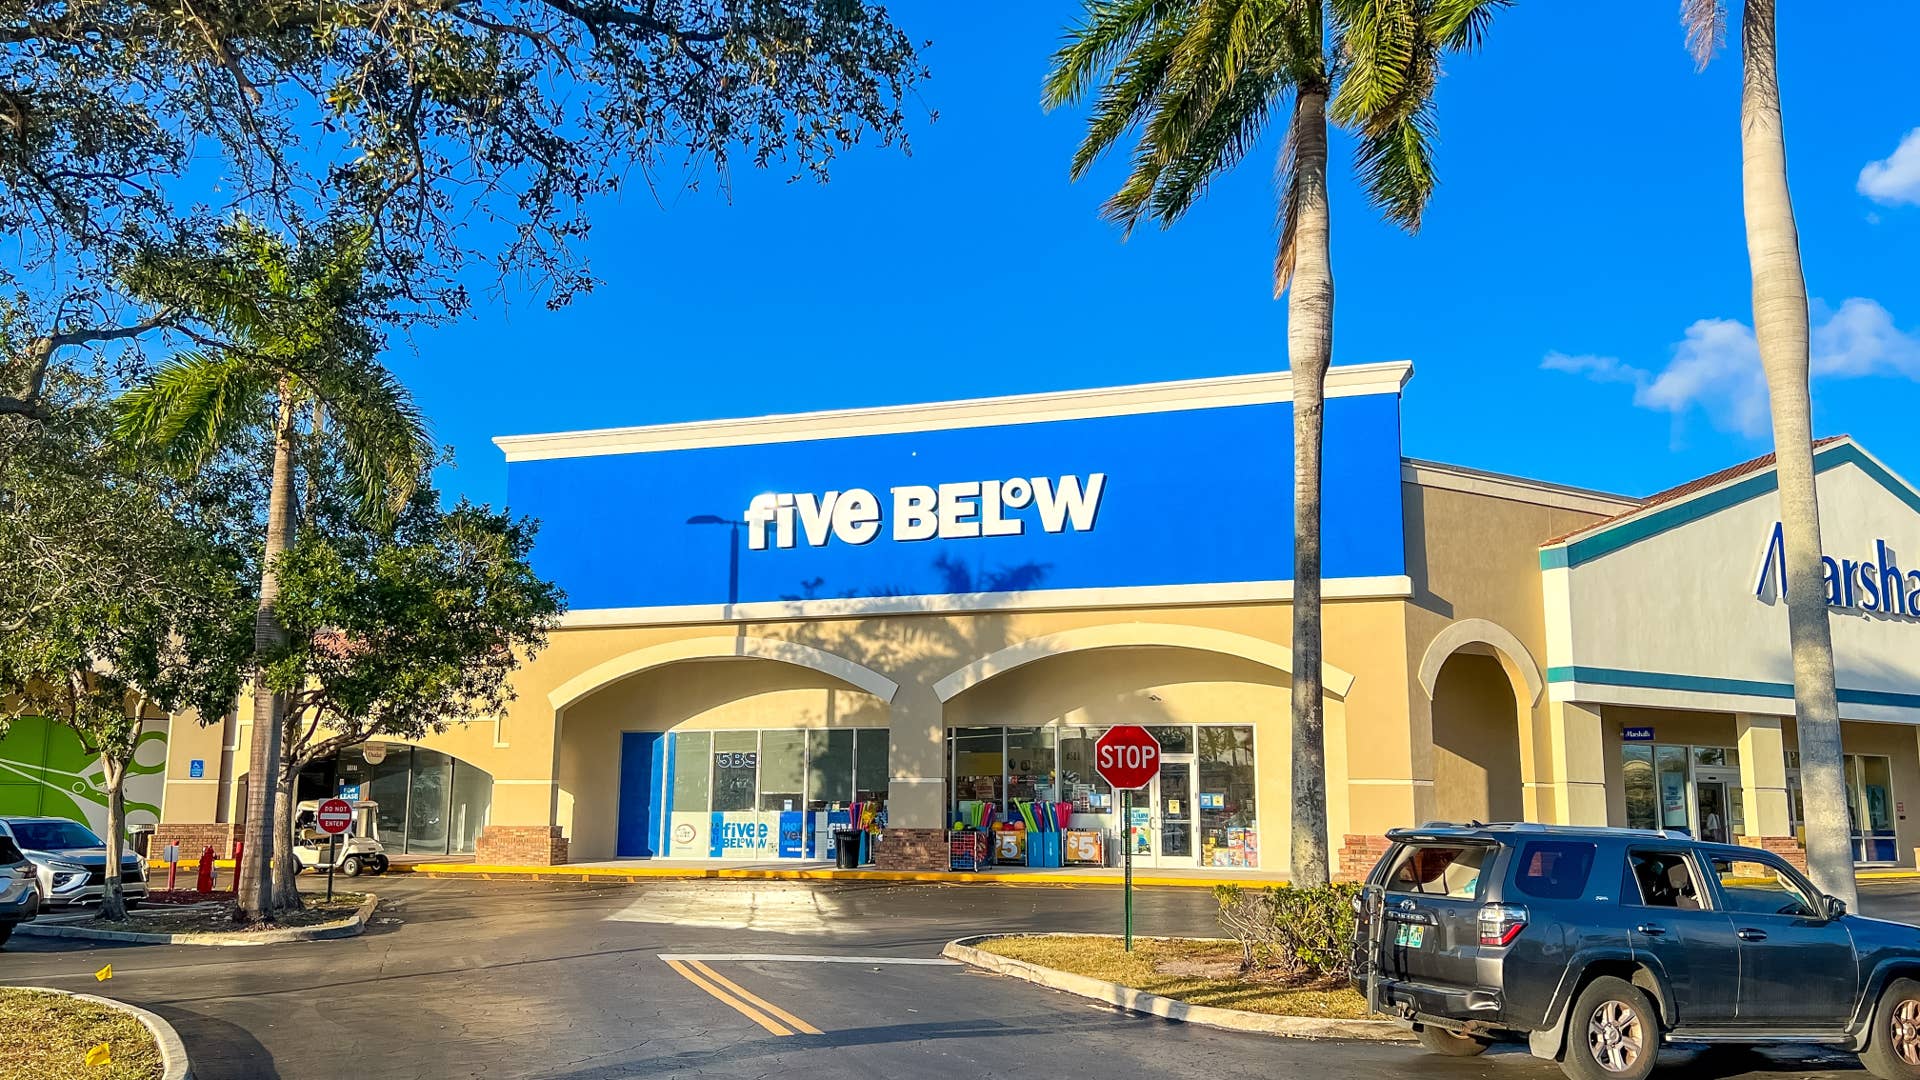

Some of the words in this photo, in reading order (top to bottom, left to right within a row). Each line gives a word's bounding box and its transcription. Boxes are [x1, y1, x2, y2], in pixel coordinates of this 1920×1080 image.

[744, 488, 882, 550] five
[1100, 745, 1156, 769] STOP
[1069, 835, 1096, 860] $5
